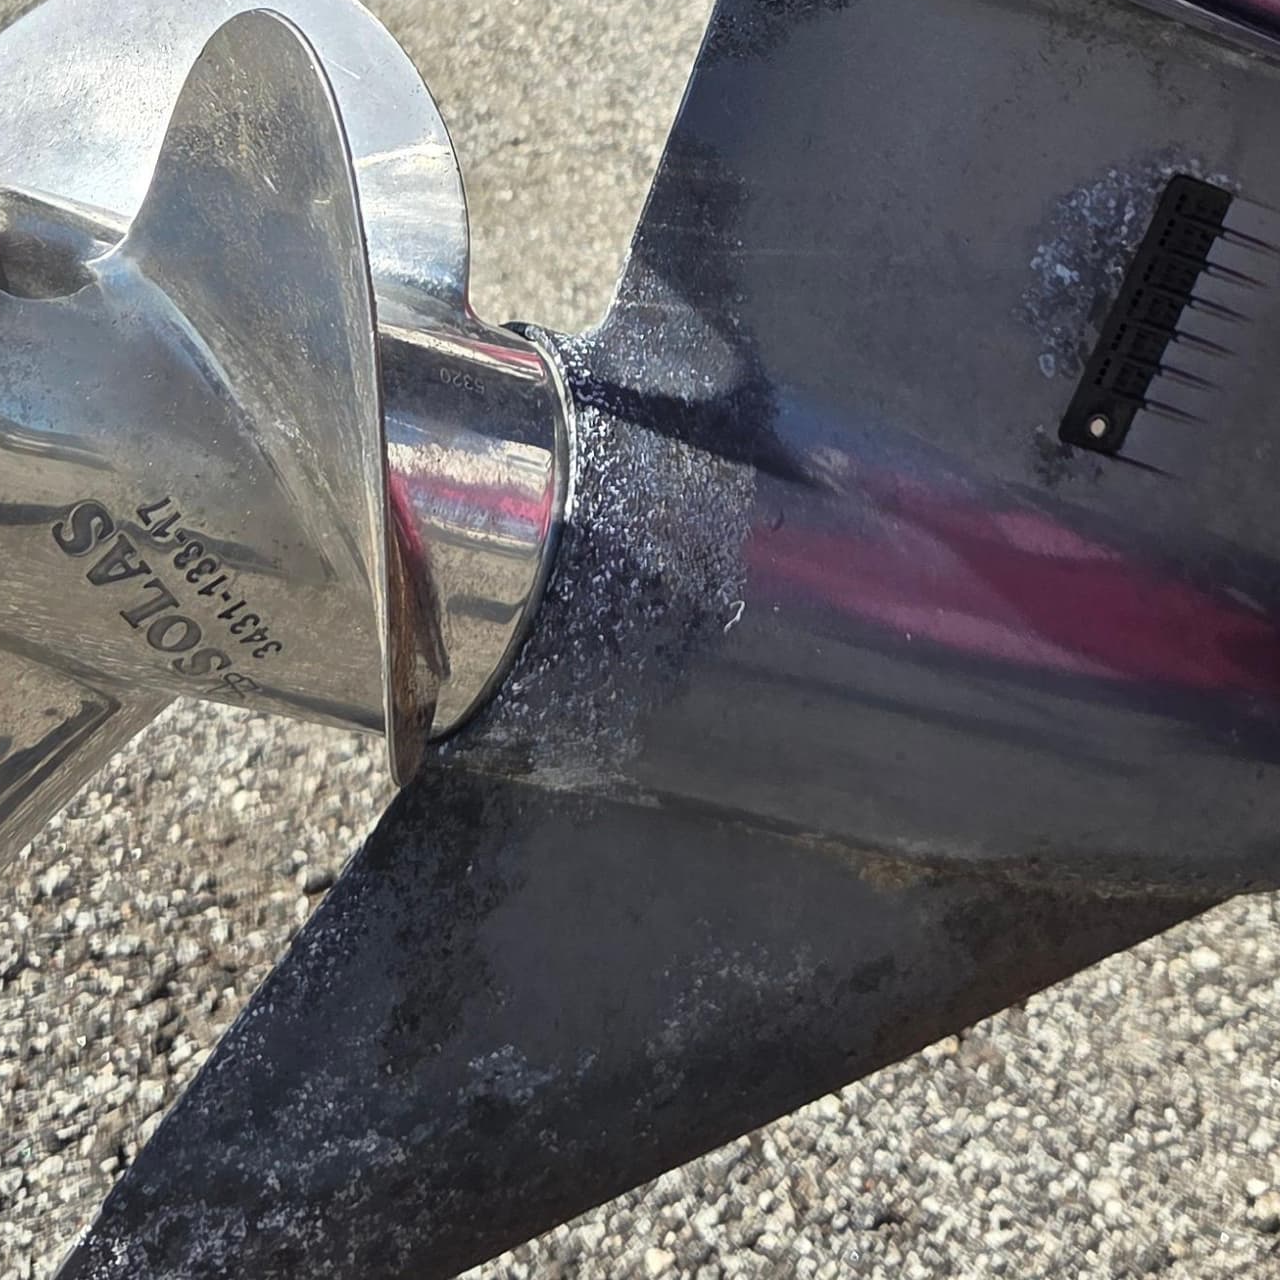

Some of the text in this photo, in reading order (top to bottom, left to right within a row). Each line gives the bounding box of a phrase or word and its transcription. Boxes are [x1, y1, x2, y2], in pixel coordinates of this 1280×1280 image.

[440, 367, 485, 395] 5320
[51, 499, 232, 677] SOLAS
[136, 495, 283, 660] 3431-133-17
